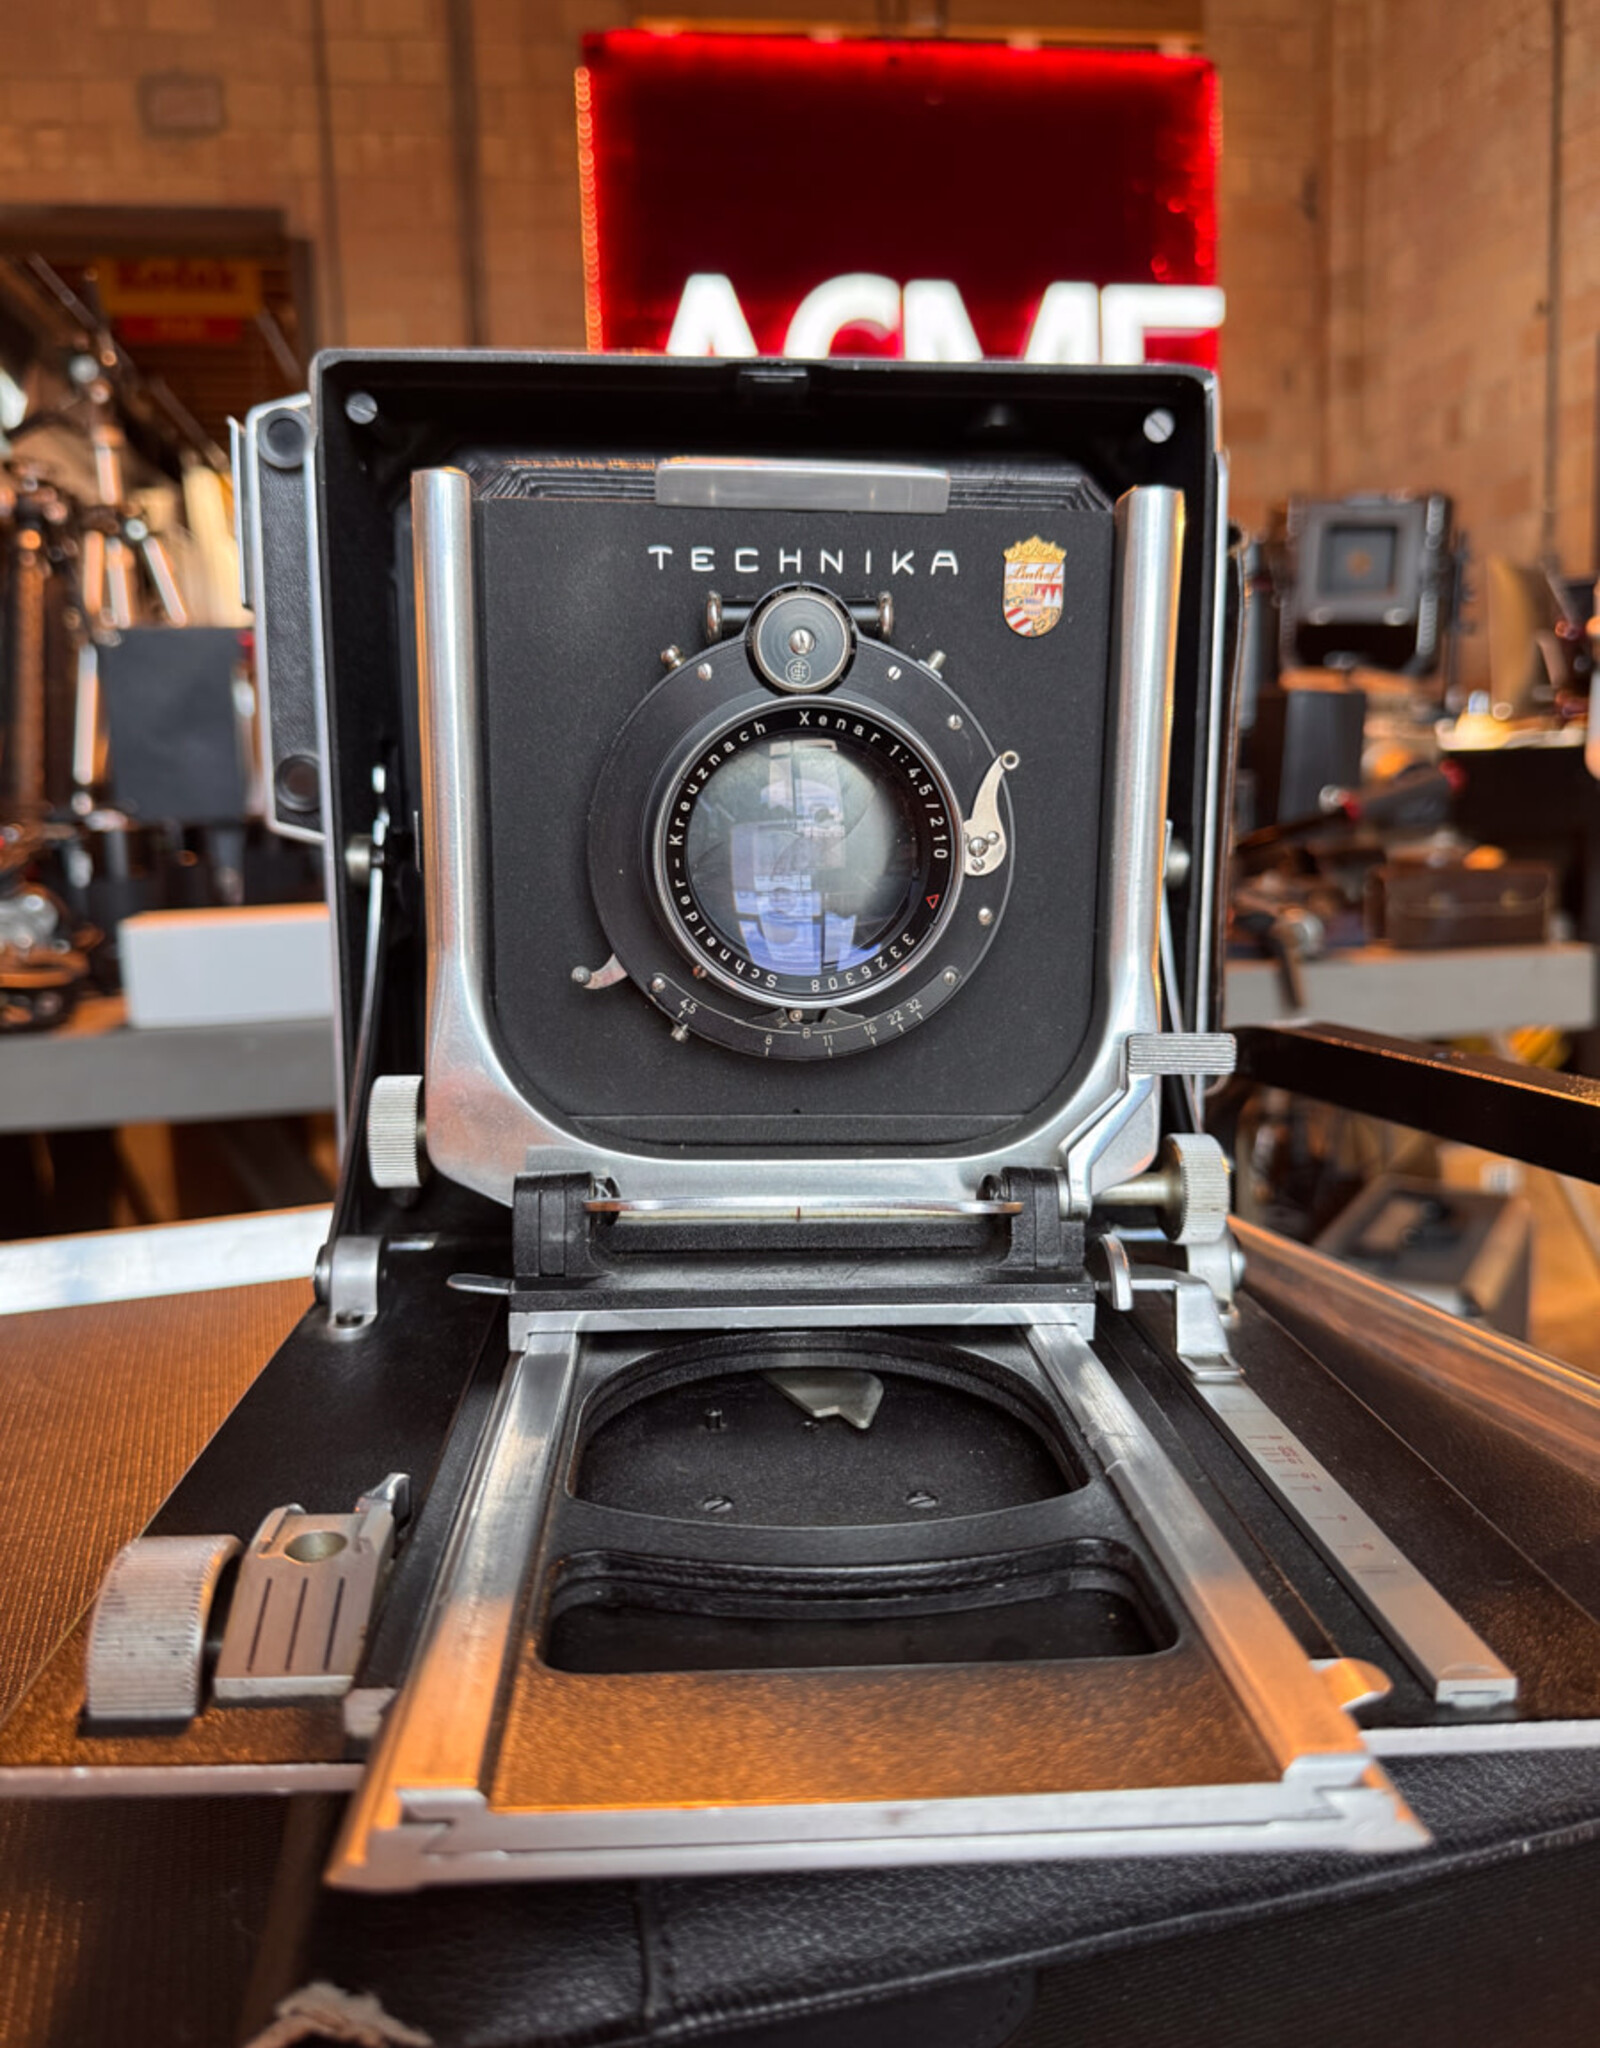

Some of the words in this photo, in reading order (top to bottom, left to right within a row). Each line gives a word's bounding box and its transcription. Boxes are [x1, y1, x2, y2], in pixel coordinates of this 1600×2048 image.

[648, 545, 959, 575] TECHNIKA
[799, 711, 881, 743] Xenar
[810, 932, 916, 993] 3326308
[863, 1022, 877, 1037] 16
[886, 1010, 904, 1026] 22
[906, 998, 923, 1013] 32
